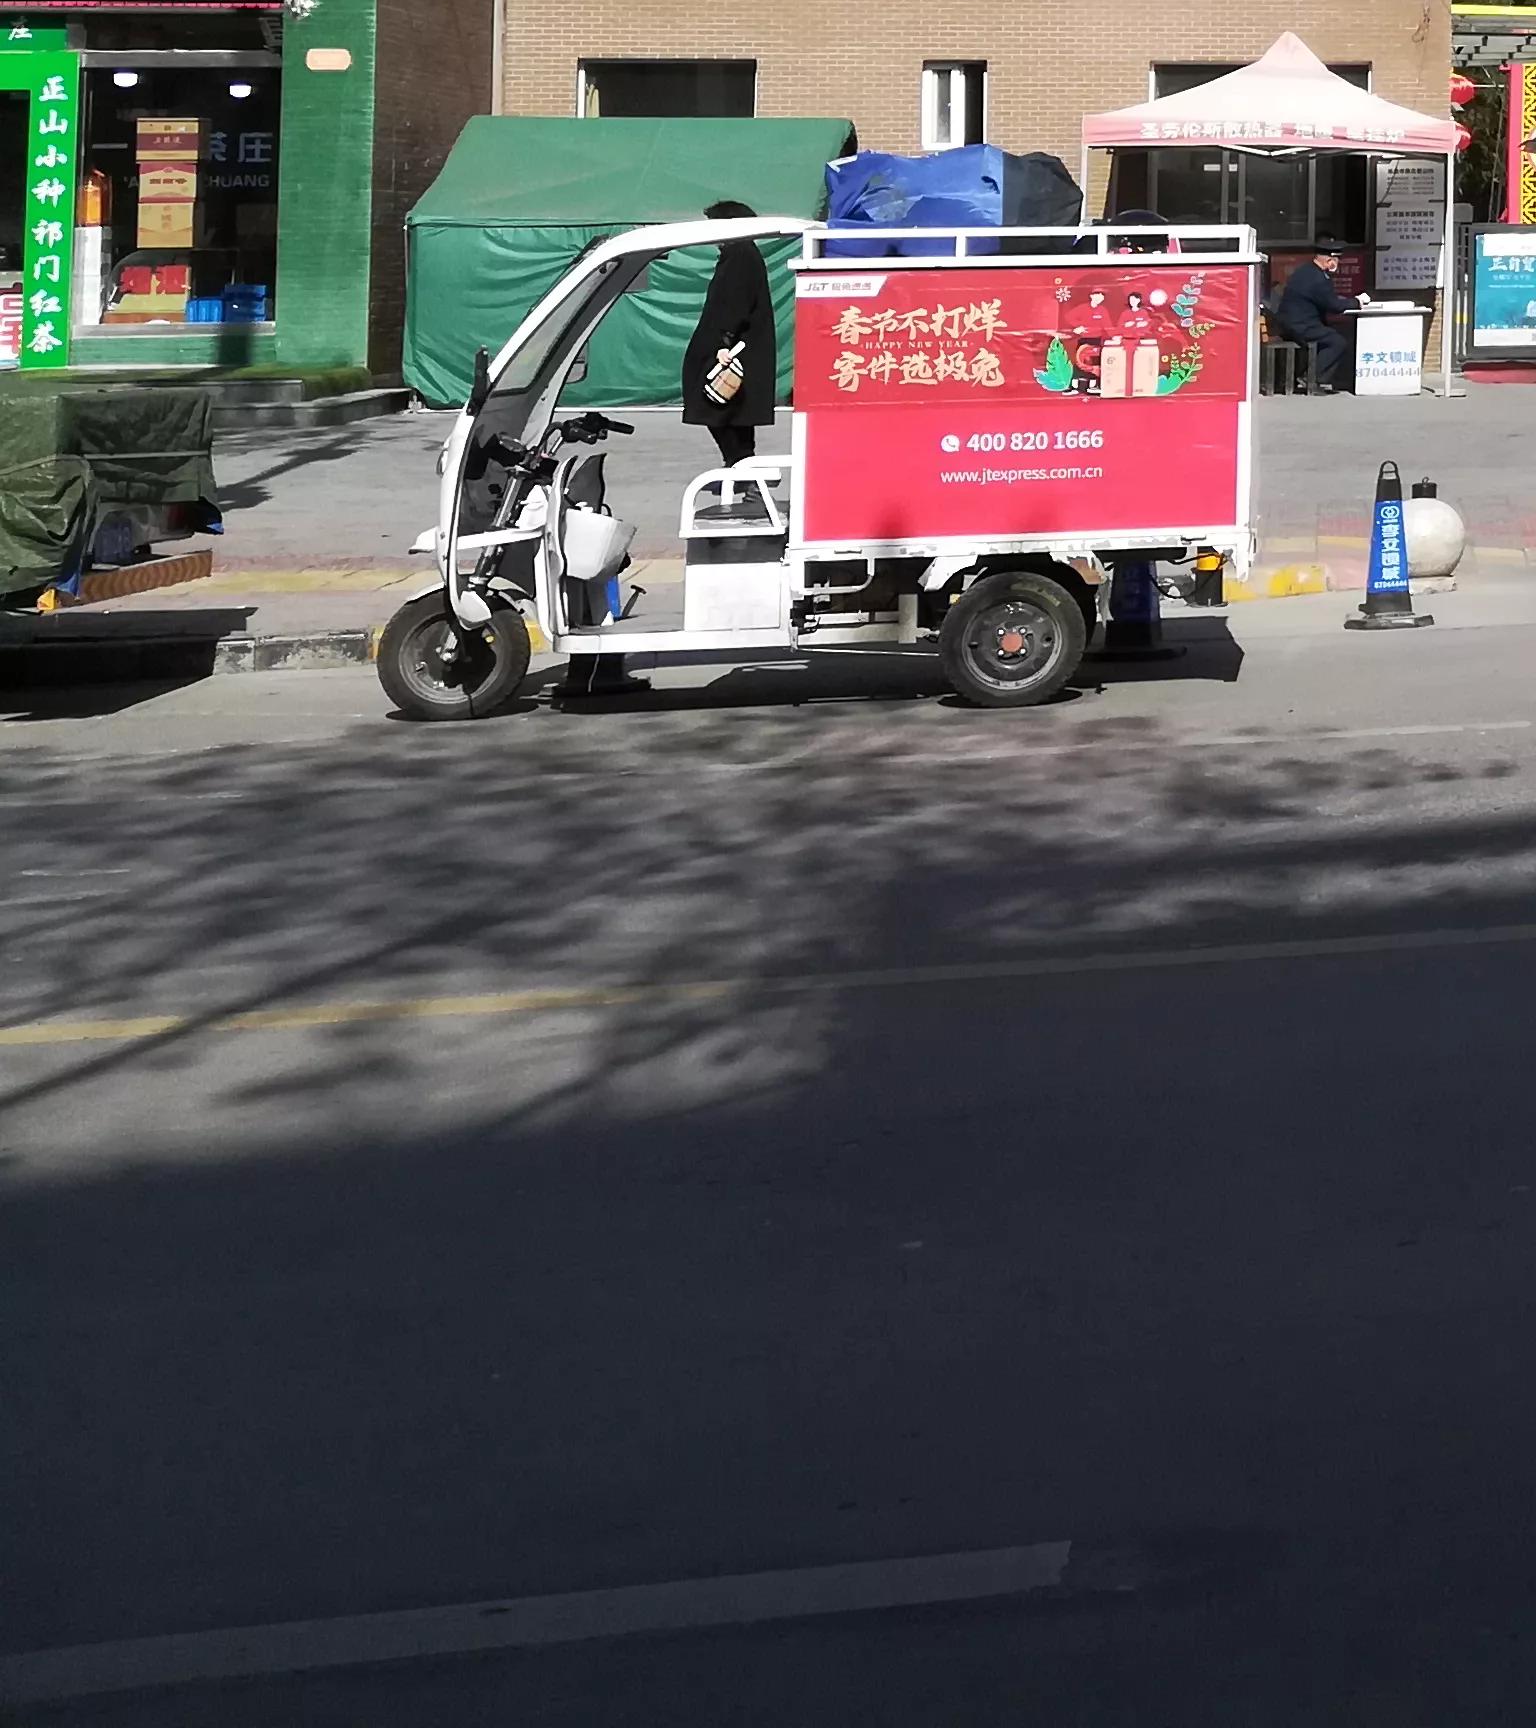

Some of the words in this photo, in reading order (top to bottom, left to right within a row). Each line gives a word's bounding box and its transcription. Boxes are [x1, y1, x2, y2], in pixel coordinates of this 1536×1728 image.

[203, 174, 270, 189] HUANG
[805, 282, 829, 292] J&T
[830, 298, 1008, 346] 春节不打烊
[864, 341, 903, 350] HAPPY
[908, 340, 933, 350] NEW
[939, 339, 969, 349] YEAR
[828, 347, 1005, 392] 寄件选极兔
[966, 433, 1006, 452] 400
[1010, 431, 1049, 451] 820
[1053, 429, 1104, 450] 1666
[940, 465, 1103, 485] www.jtexpress.com.cn
